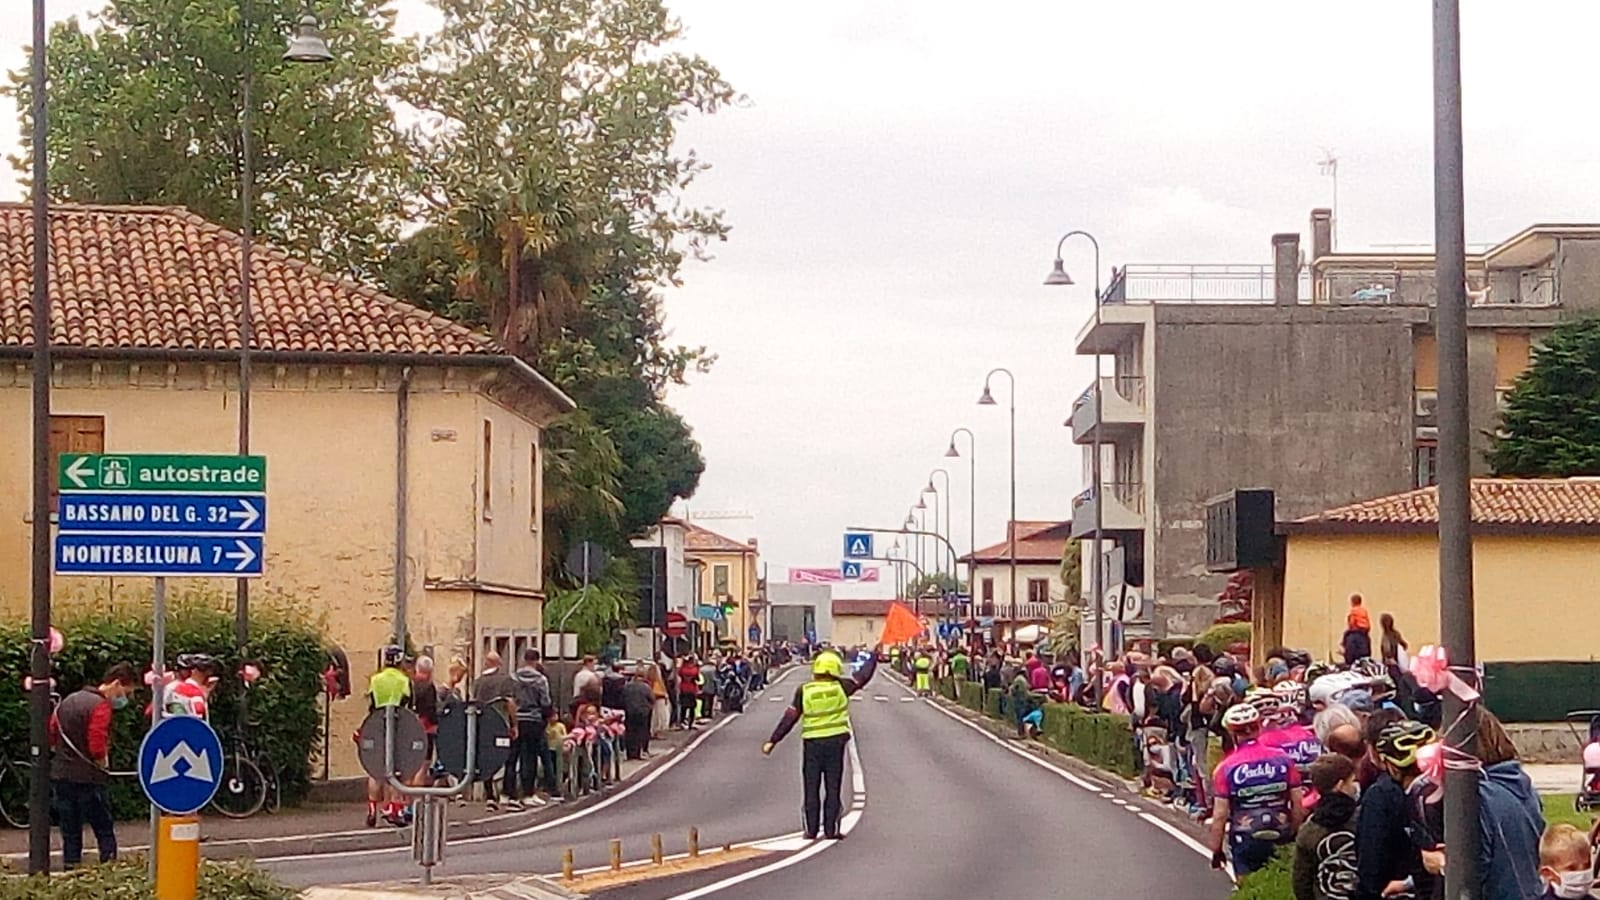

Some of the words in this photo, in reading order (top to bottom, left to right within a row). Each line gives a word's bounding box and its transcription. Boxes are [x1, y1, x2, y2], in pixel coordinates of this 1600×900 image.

[139, 465, 260, 483] autostrade
[65, 504, 145, 522] BASSANO
[151, 505, 180, 522] DEL
[185, 506, 202, 522] G.
[207, 506, 228, 522] 32
[61, 545, 202, 564] MONTEBELLUNA
[212, 546, 223, 564] 7
